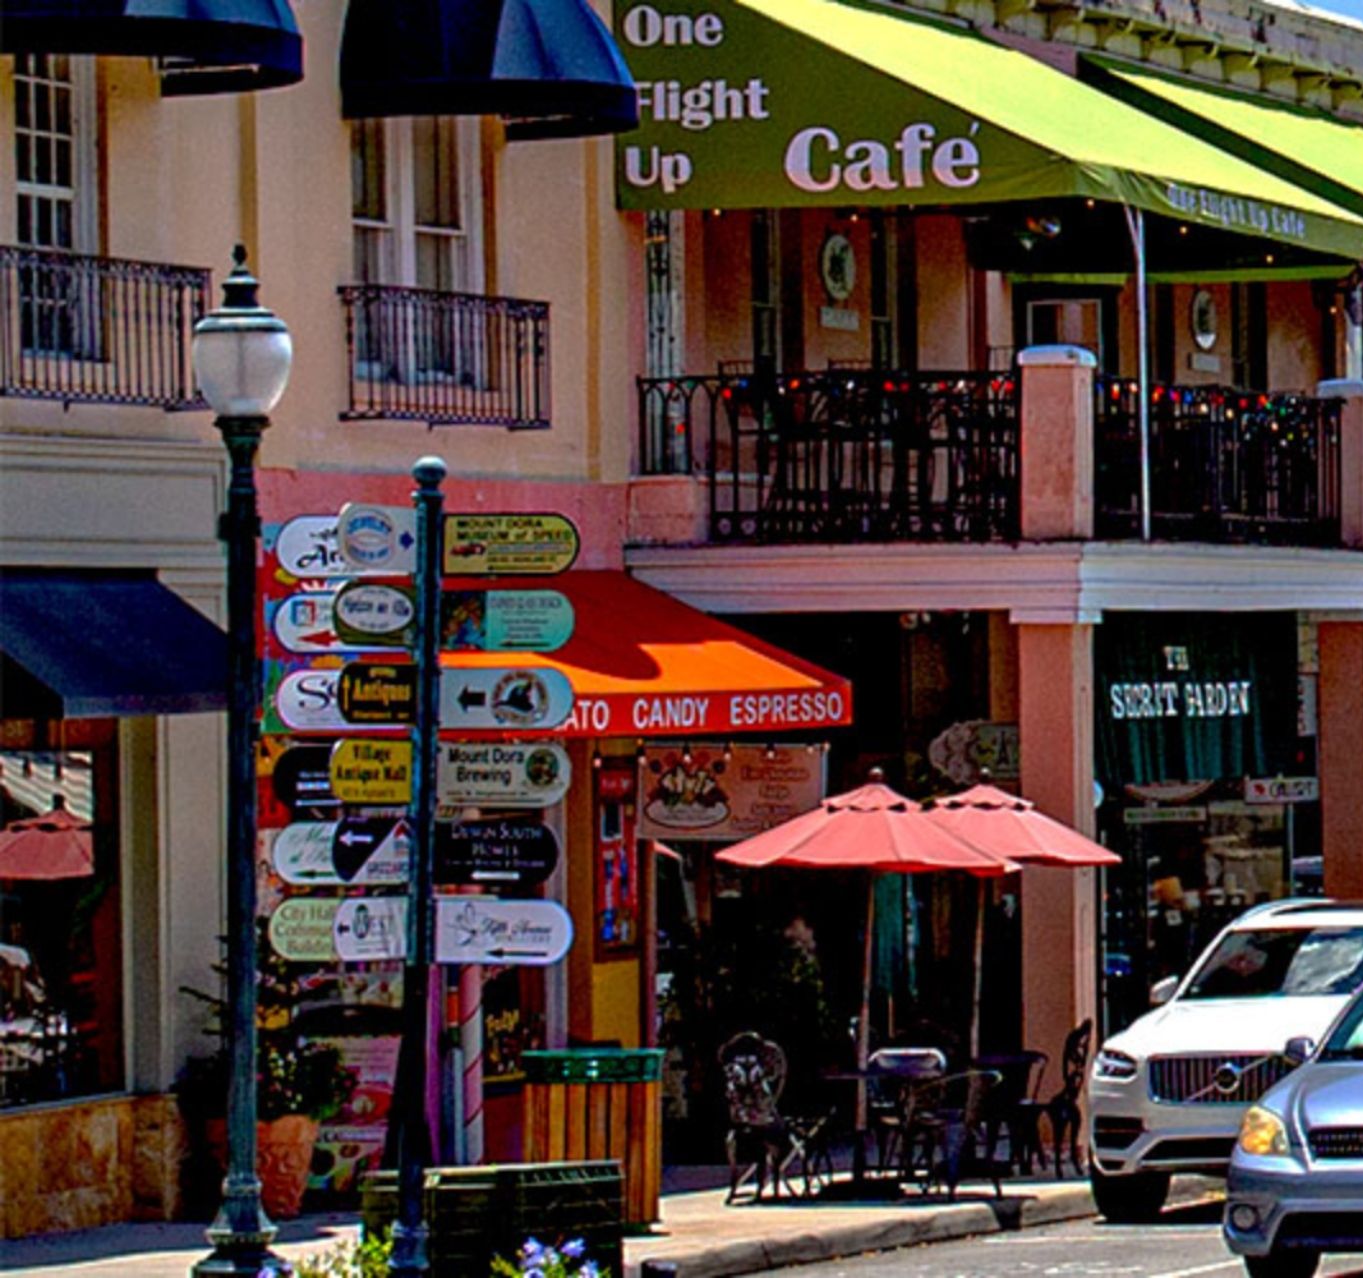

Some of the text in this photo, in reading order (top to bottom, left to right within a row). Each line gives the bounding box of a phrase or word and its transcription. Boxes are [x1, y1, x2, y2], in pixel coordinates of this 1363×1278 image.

[623, 4, 723, 46] One
[634, 79, 770, 130] Flight
[624, 146, 693, 193] Up
[457, 518, 543, 528] MOUNT DORA
[457, 530, 509, 541] MUSEUM
[533, 530, 573, 540] SPEED
[1110, 681, 1251, 719] SECRET GARDEN
[555, 691, 844, 732] ATO CANDY ESPRESSO
[353, 744, 392, 762] Village
[448, 748, 524, 764] Mount Dora
[337, 766, 379, 784] Antique
[383, 766, 407, 781] Mall
[456, 766, 512, 786] Brewing
[281, 905, 307, 921] City
